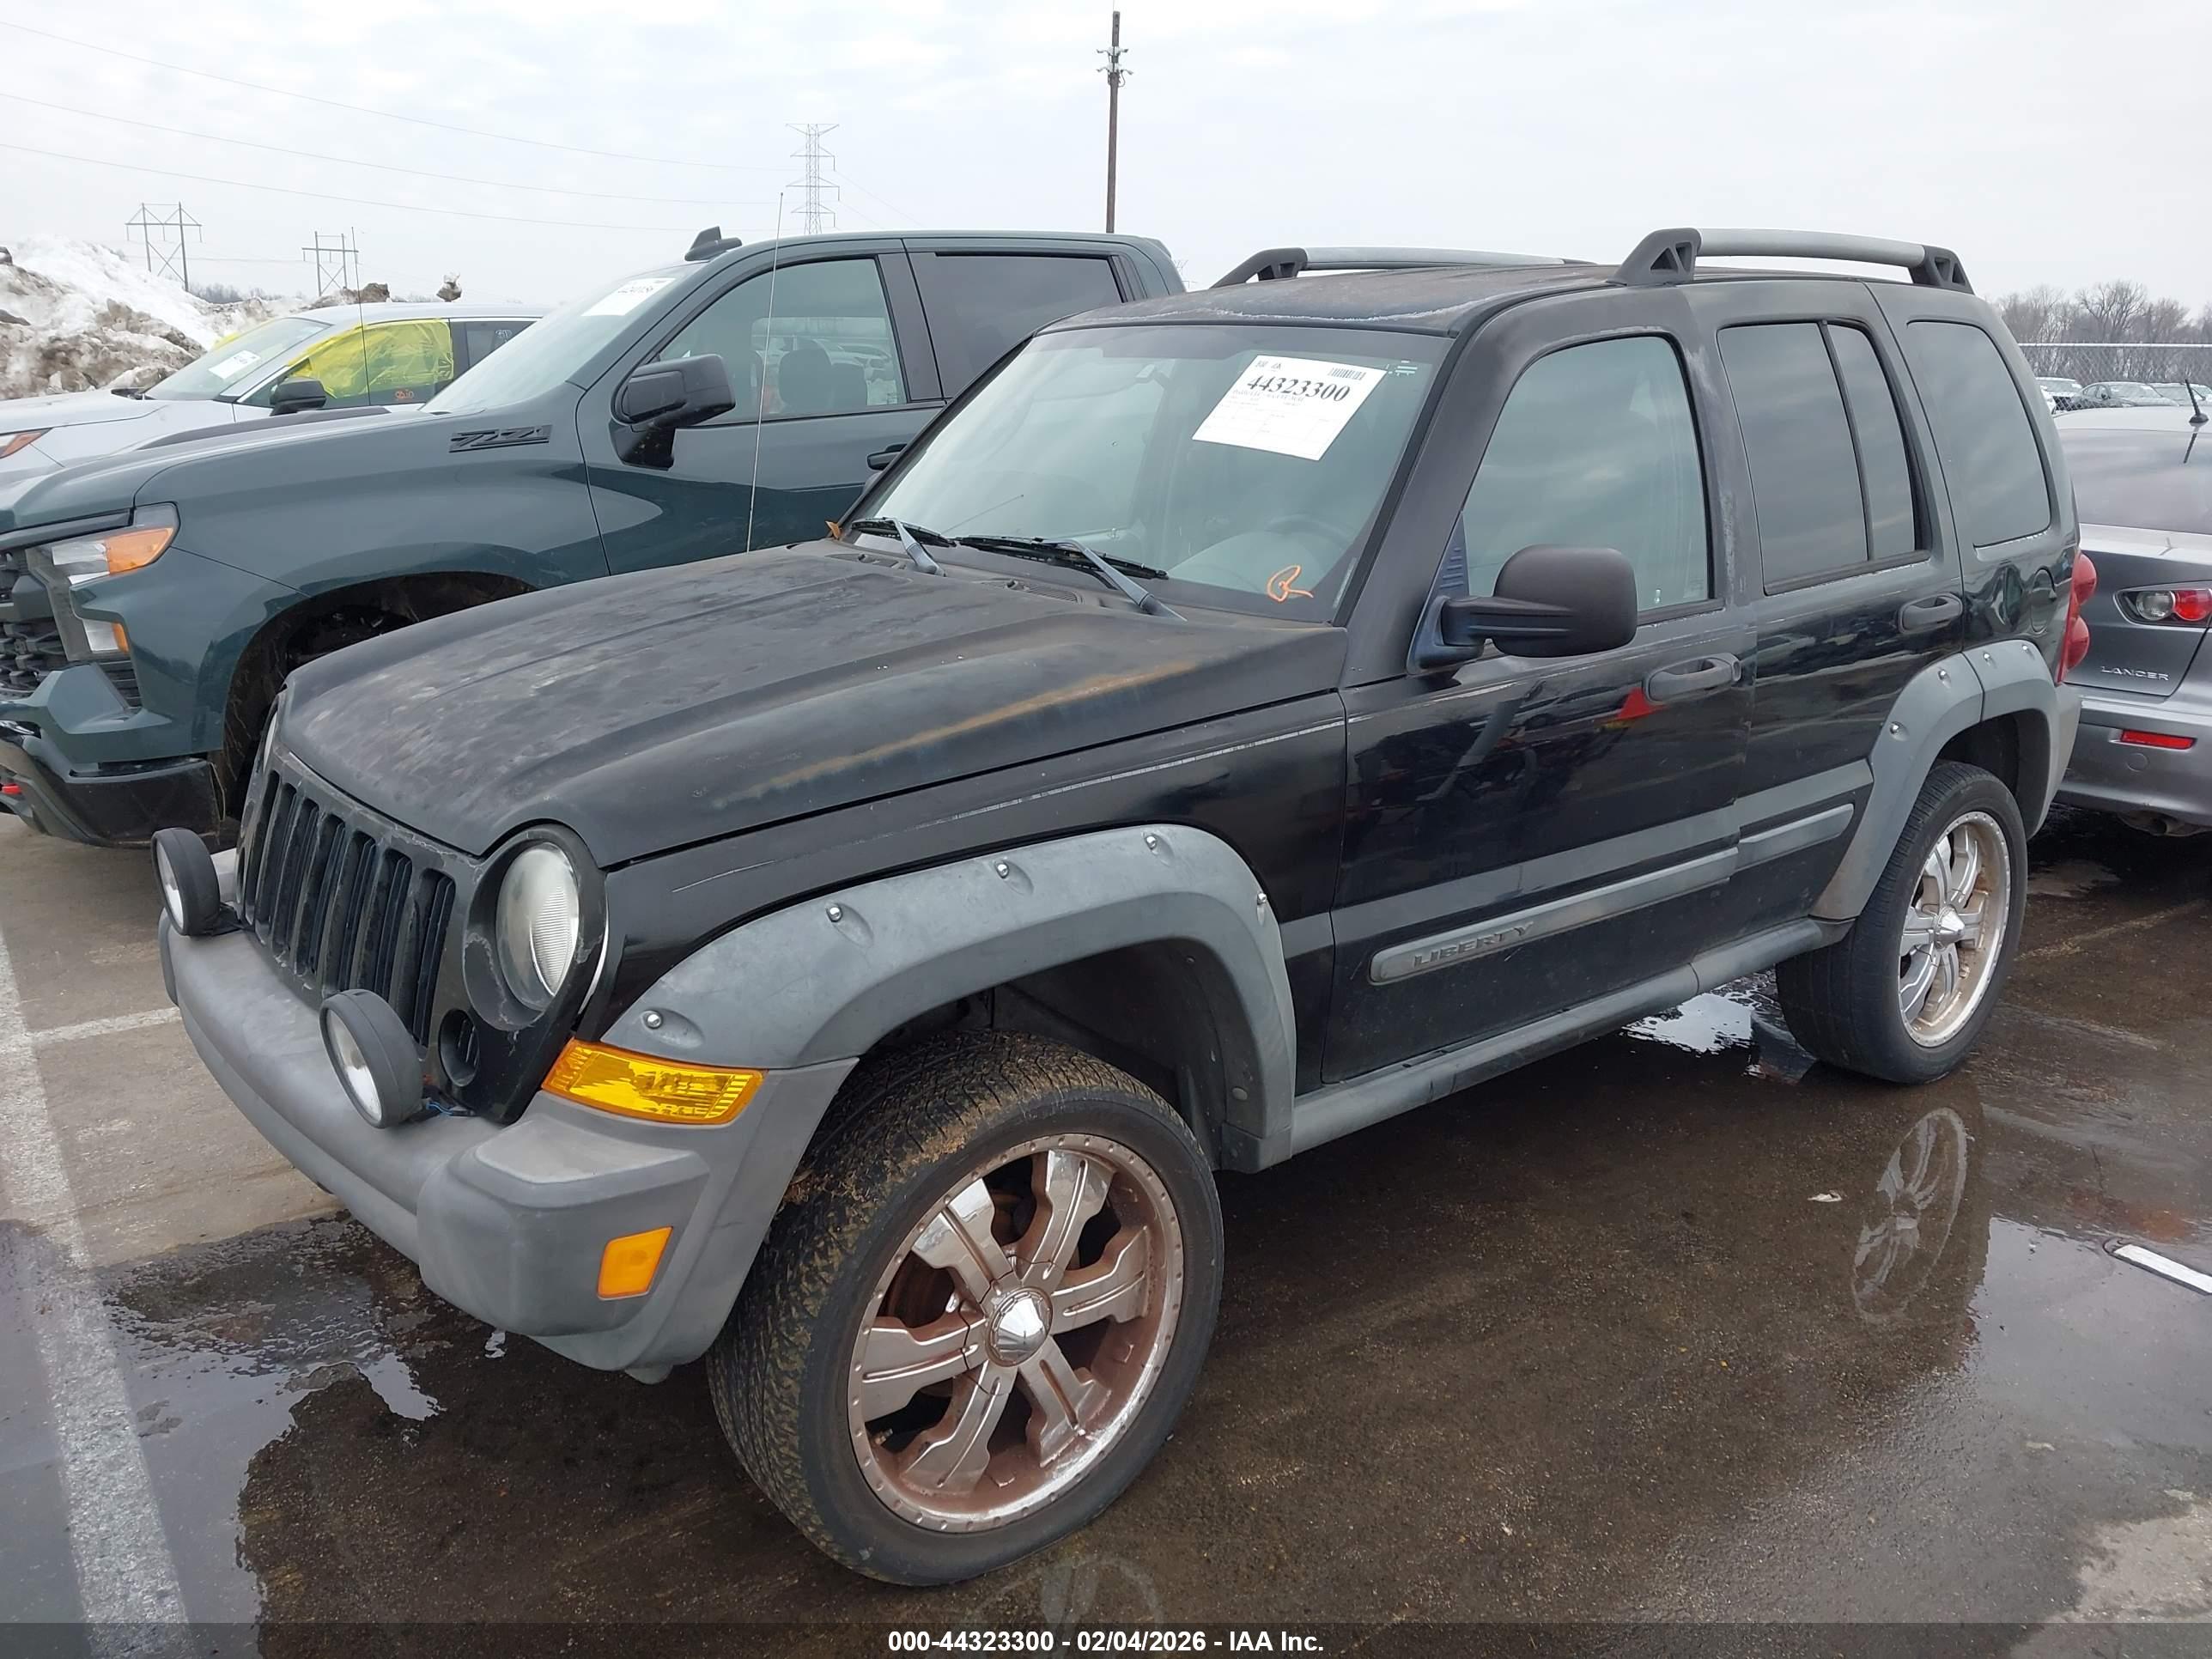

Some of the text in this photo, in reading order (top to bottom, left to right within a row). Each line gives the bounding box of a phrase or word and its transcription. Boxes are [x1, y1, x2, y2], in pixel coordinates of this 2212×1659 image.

[1247, 375, 1351, 401] 44323300
[2100, 665, 2169, 681] LANCER
[1413, 921, 1534, 968] LIBERTY
